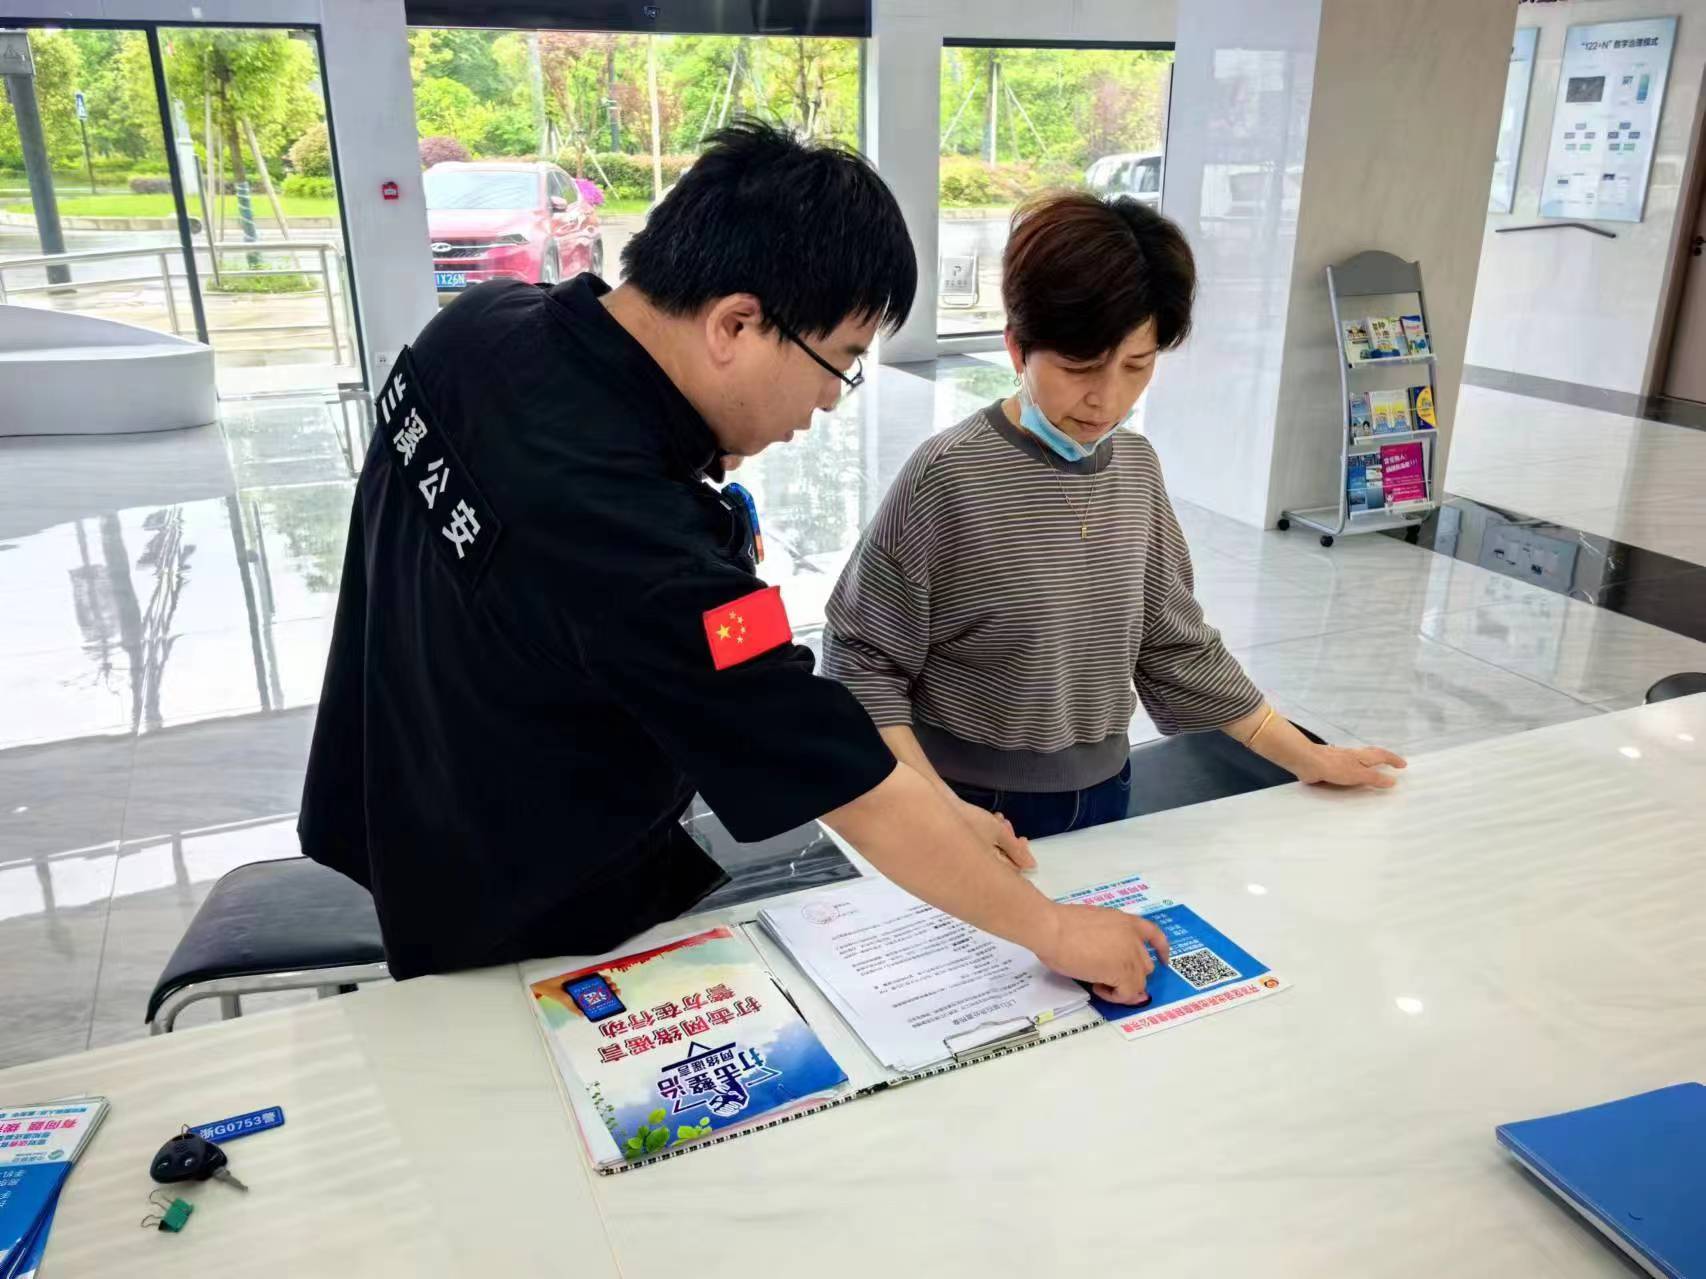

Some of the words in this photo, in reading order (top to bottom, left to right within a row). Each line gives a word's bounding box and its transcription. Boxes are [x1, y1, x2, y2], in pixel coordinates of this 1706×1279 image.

[598, 996, 762, 1063] 打击网络谣言
[599, 984, 735, 1038] 警方在行动
[657, 1048, 764, 1098] 打击整治
[677, 1050, 735, 1077] 网络谣言
